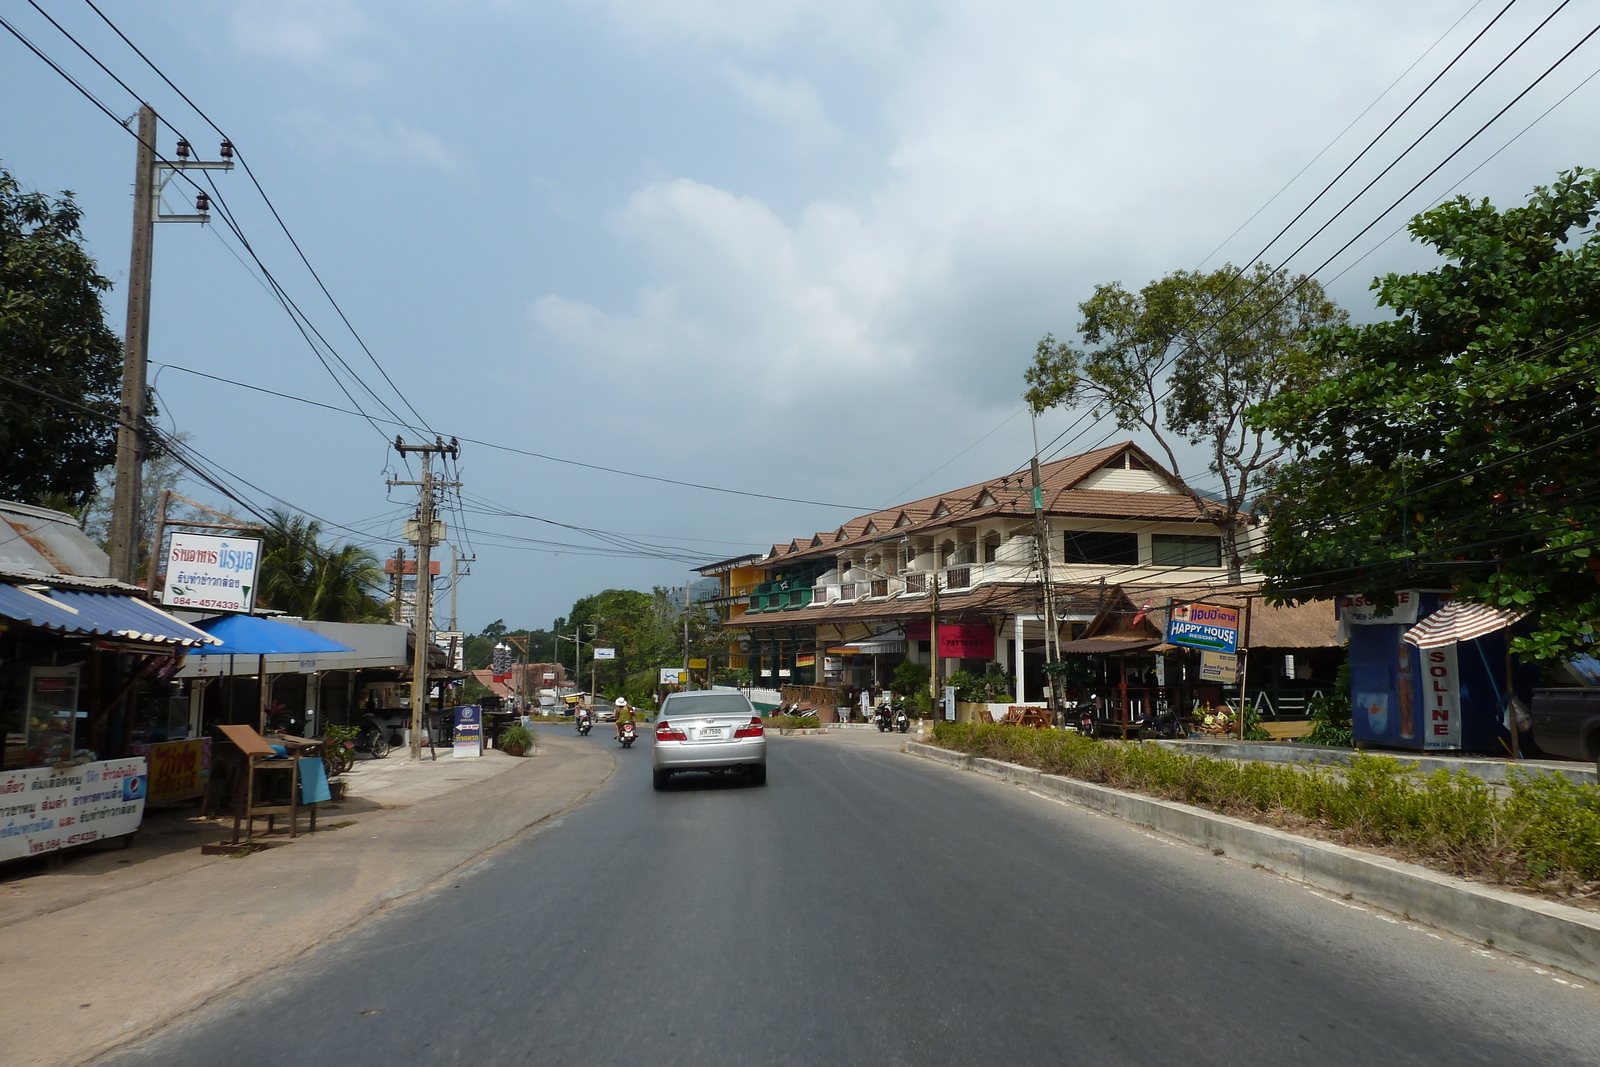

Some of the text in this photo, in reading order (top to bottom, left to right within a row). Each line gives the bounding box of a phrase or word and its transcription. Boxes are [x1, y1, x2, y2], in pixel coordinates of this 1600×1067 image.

[171, 543, 218, 564] ร้านอาหาร
[173, 597, 239, 609] 084-4574339
[1171, 622, 1202, 636] HAPPY
[1204, 627, 1234, 645] HOUSE
